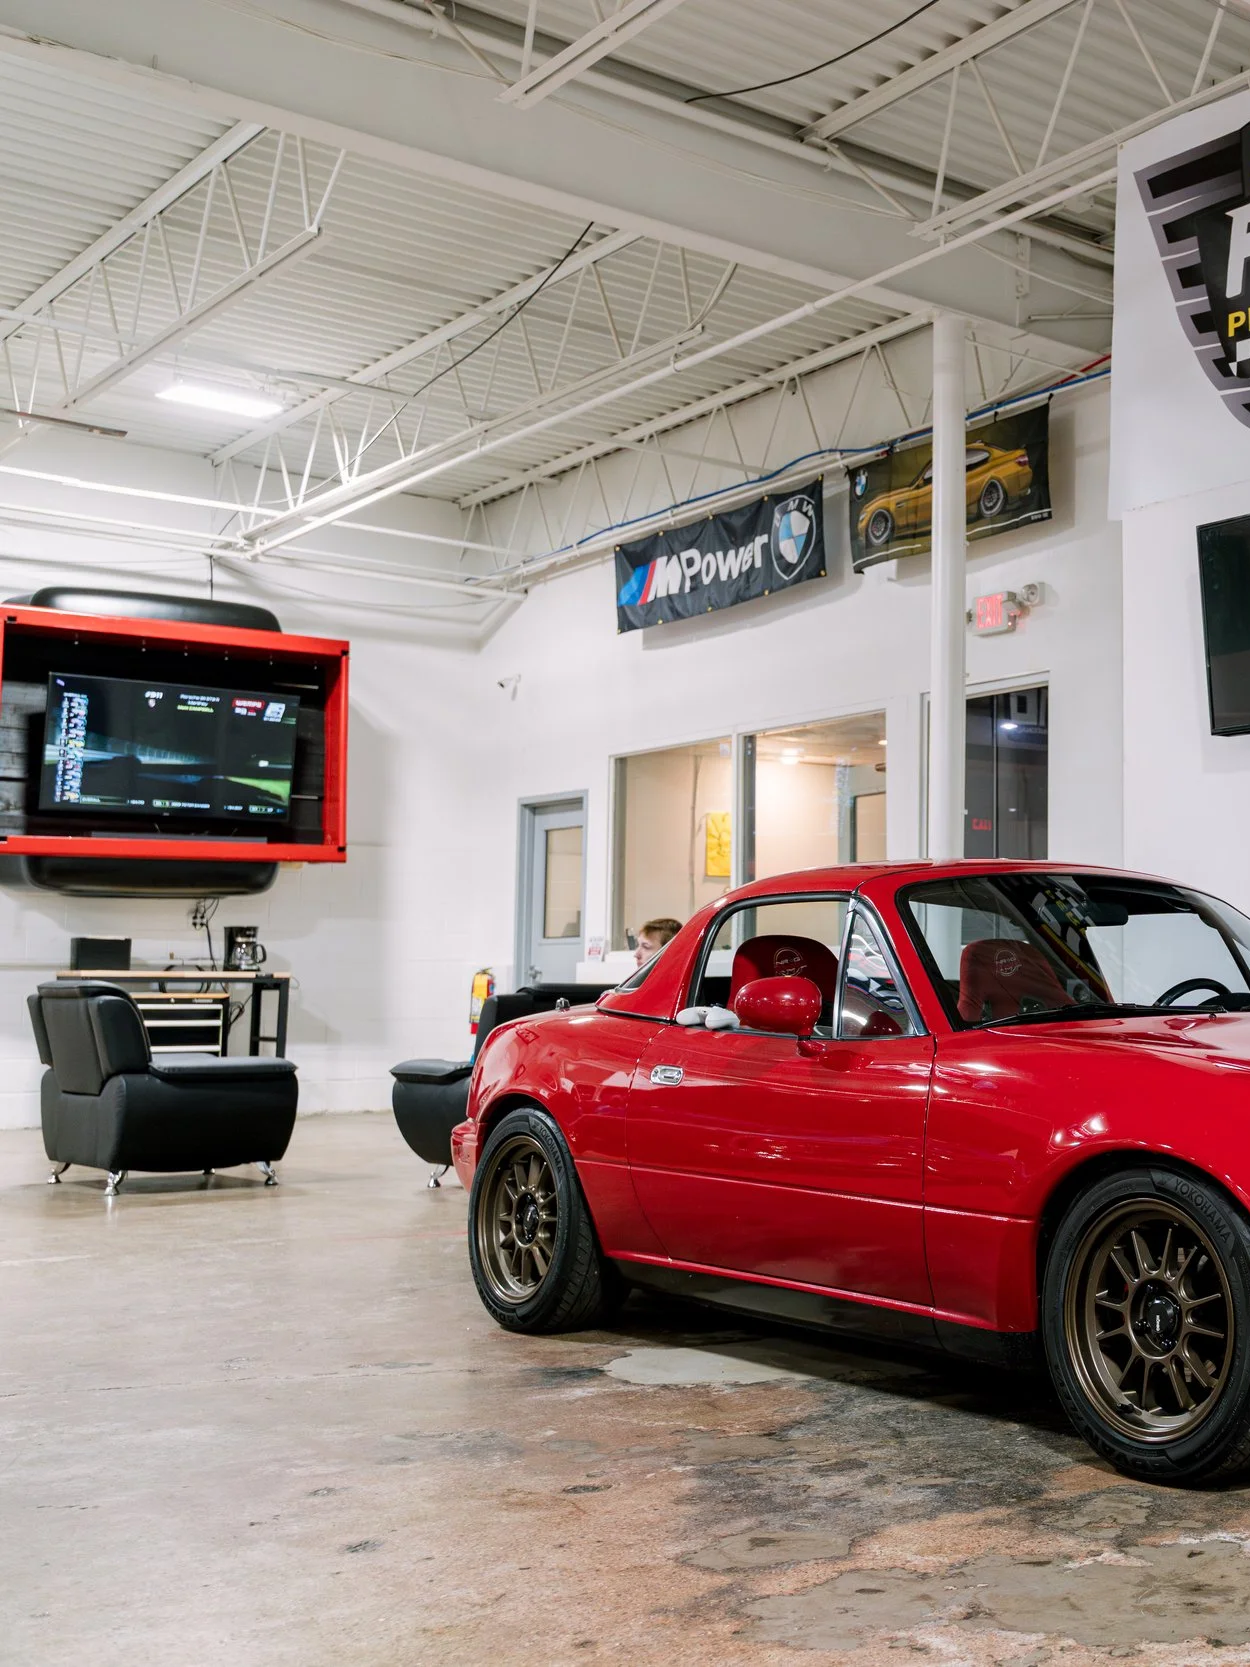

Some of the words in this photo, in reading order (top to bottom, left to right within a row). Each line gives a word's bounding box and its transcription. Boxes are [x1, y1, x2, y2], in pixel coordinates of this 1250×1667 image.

[977, 594, 1003, 629] EXIT
[540, 1125, 563, 1173] YOKOHAMA
[1175, 1178, 1232, 1243] YOKOHAMA
